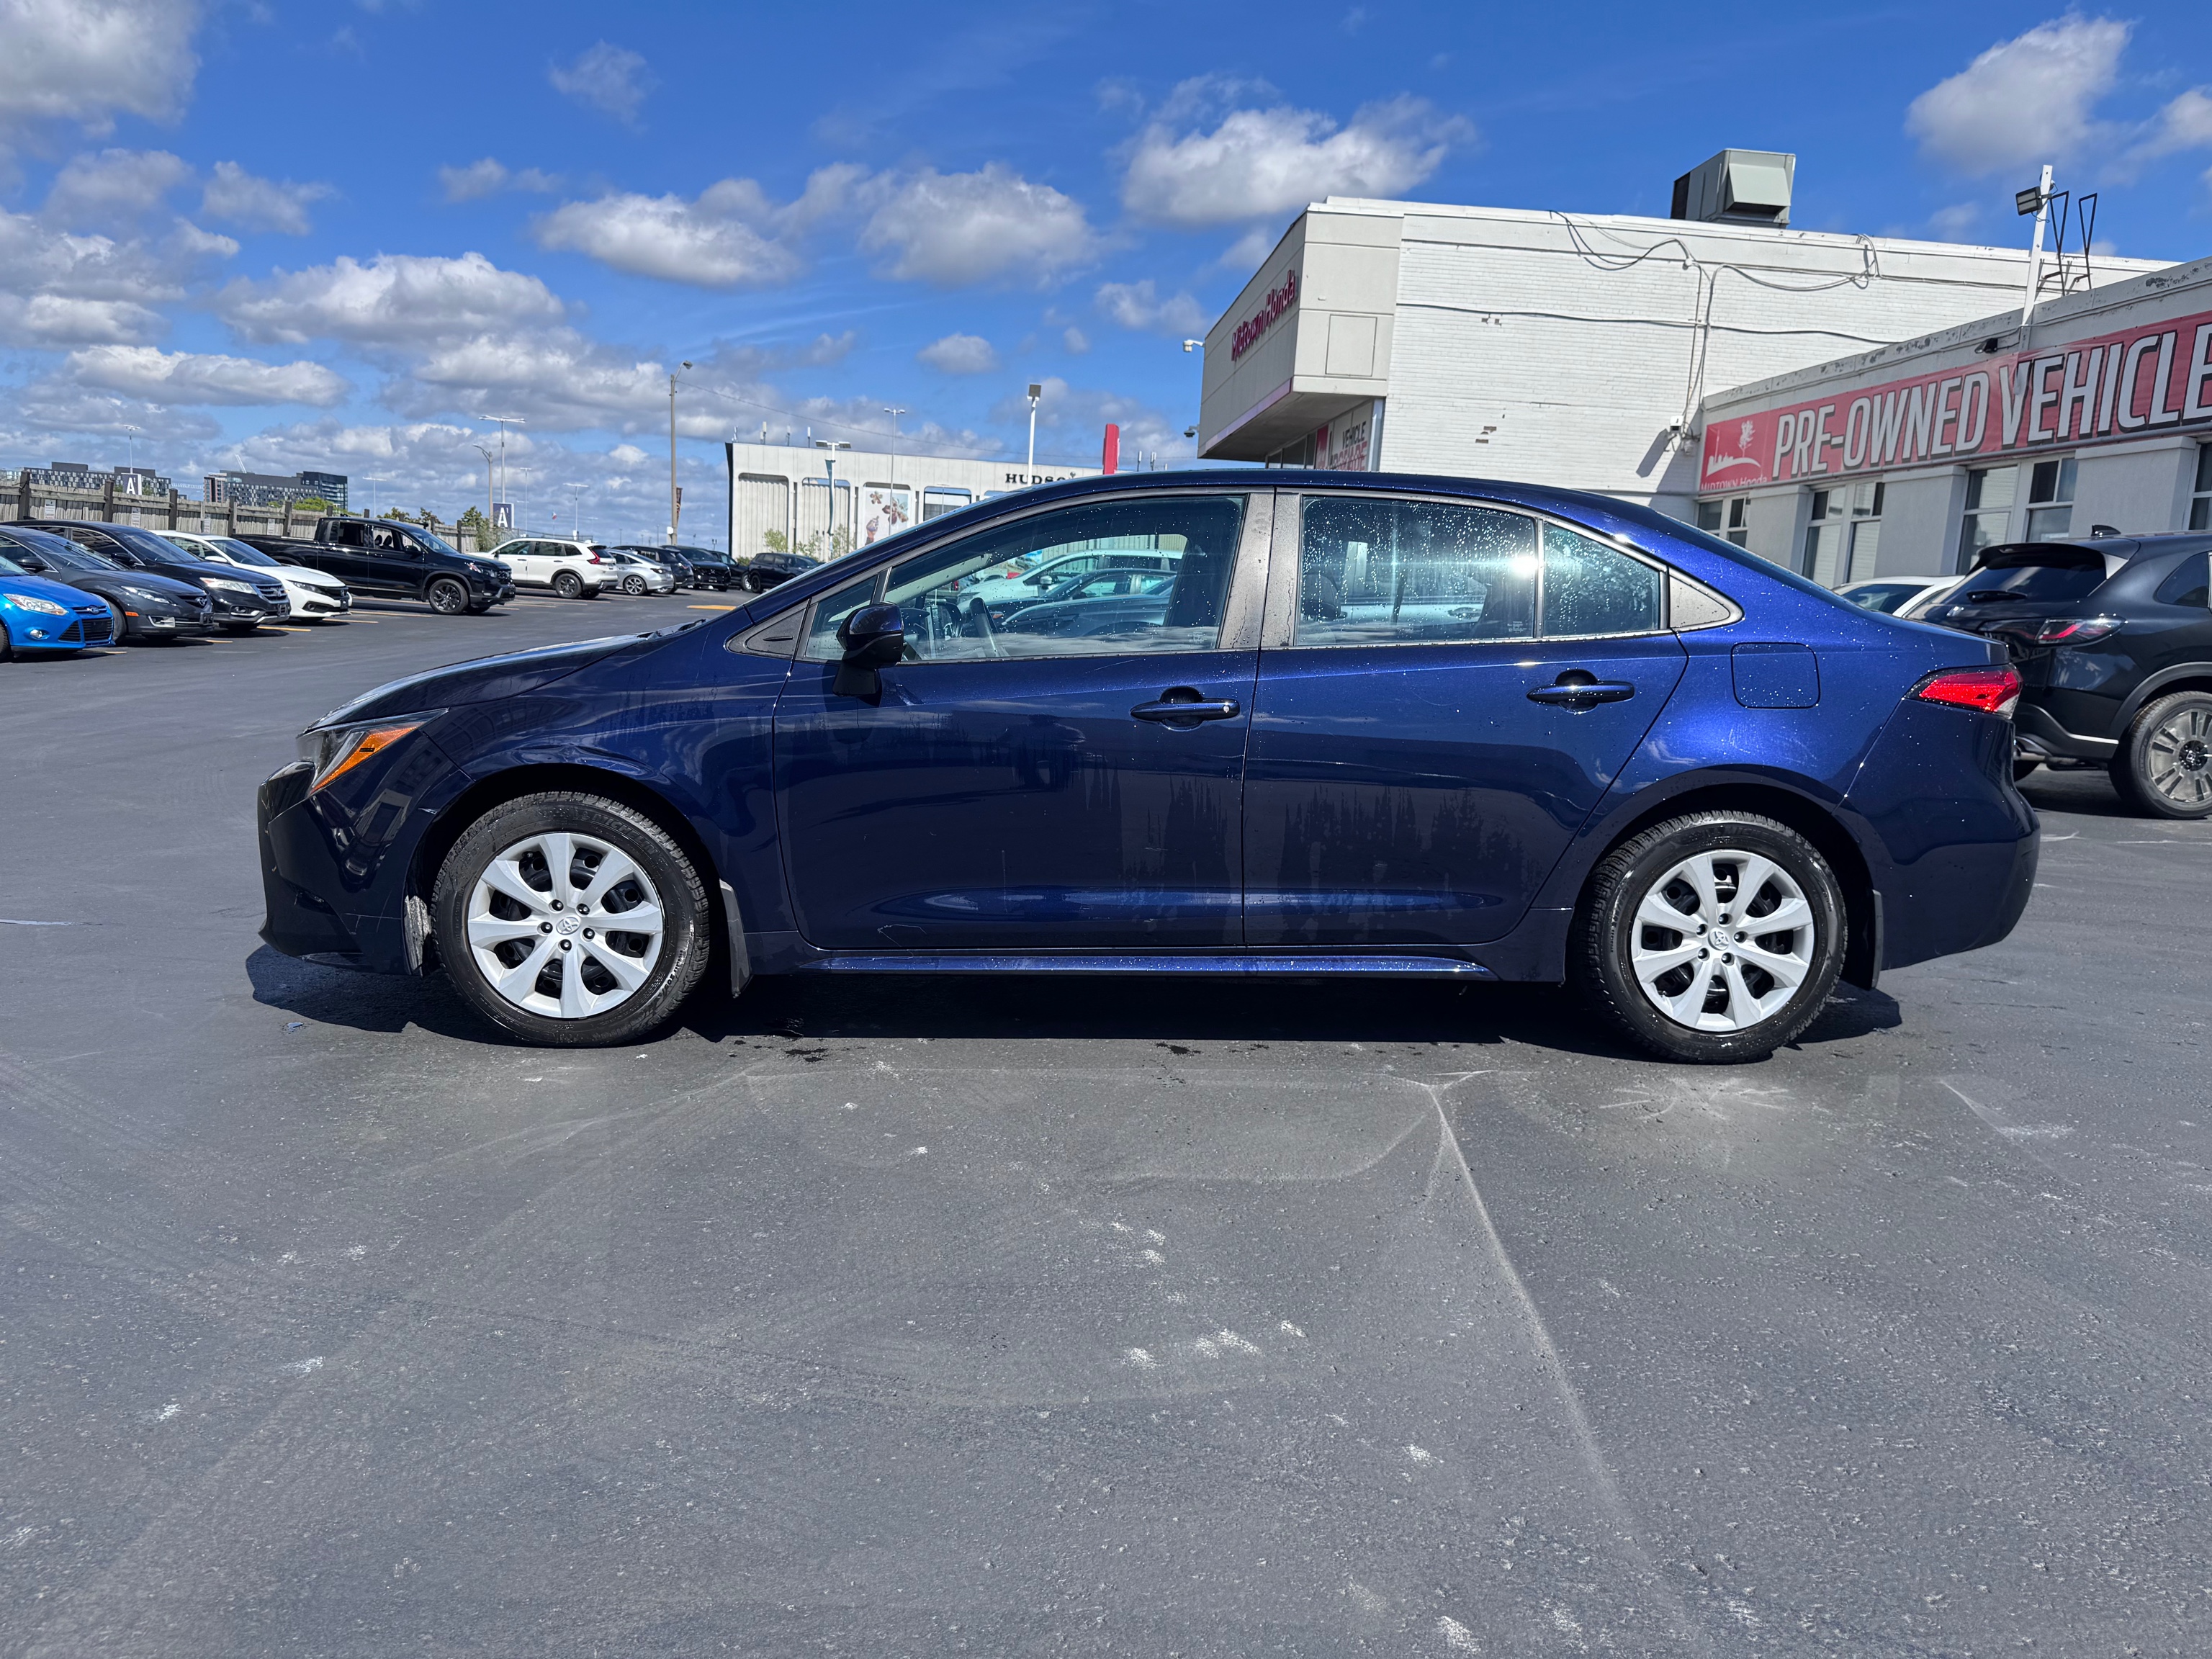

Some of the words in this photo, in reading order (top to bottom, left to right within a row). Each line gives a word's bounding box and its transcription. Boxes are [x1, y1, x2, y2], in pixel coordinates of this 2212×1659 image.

[1265, 269, 1295, 328] Honda
[1771, 371, 1991, 480] PRE-OWNED
[1005, 473, 1066, 485] HUDS
[1740, 474, 1768, 485] Honda
[592, 814, 659, 855] MICHELIN
